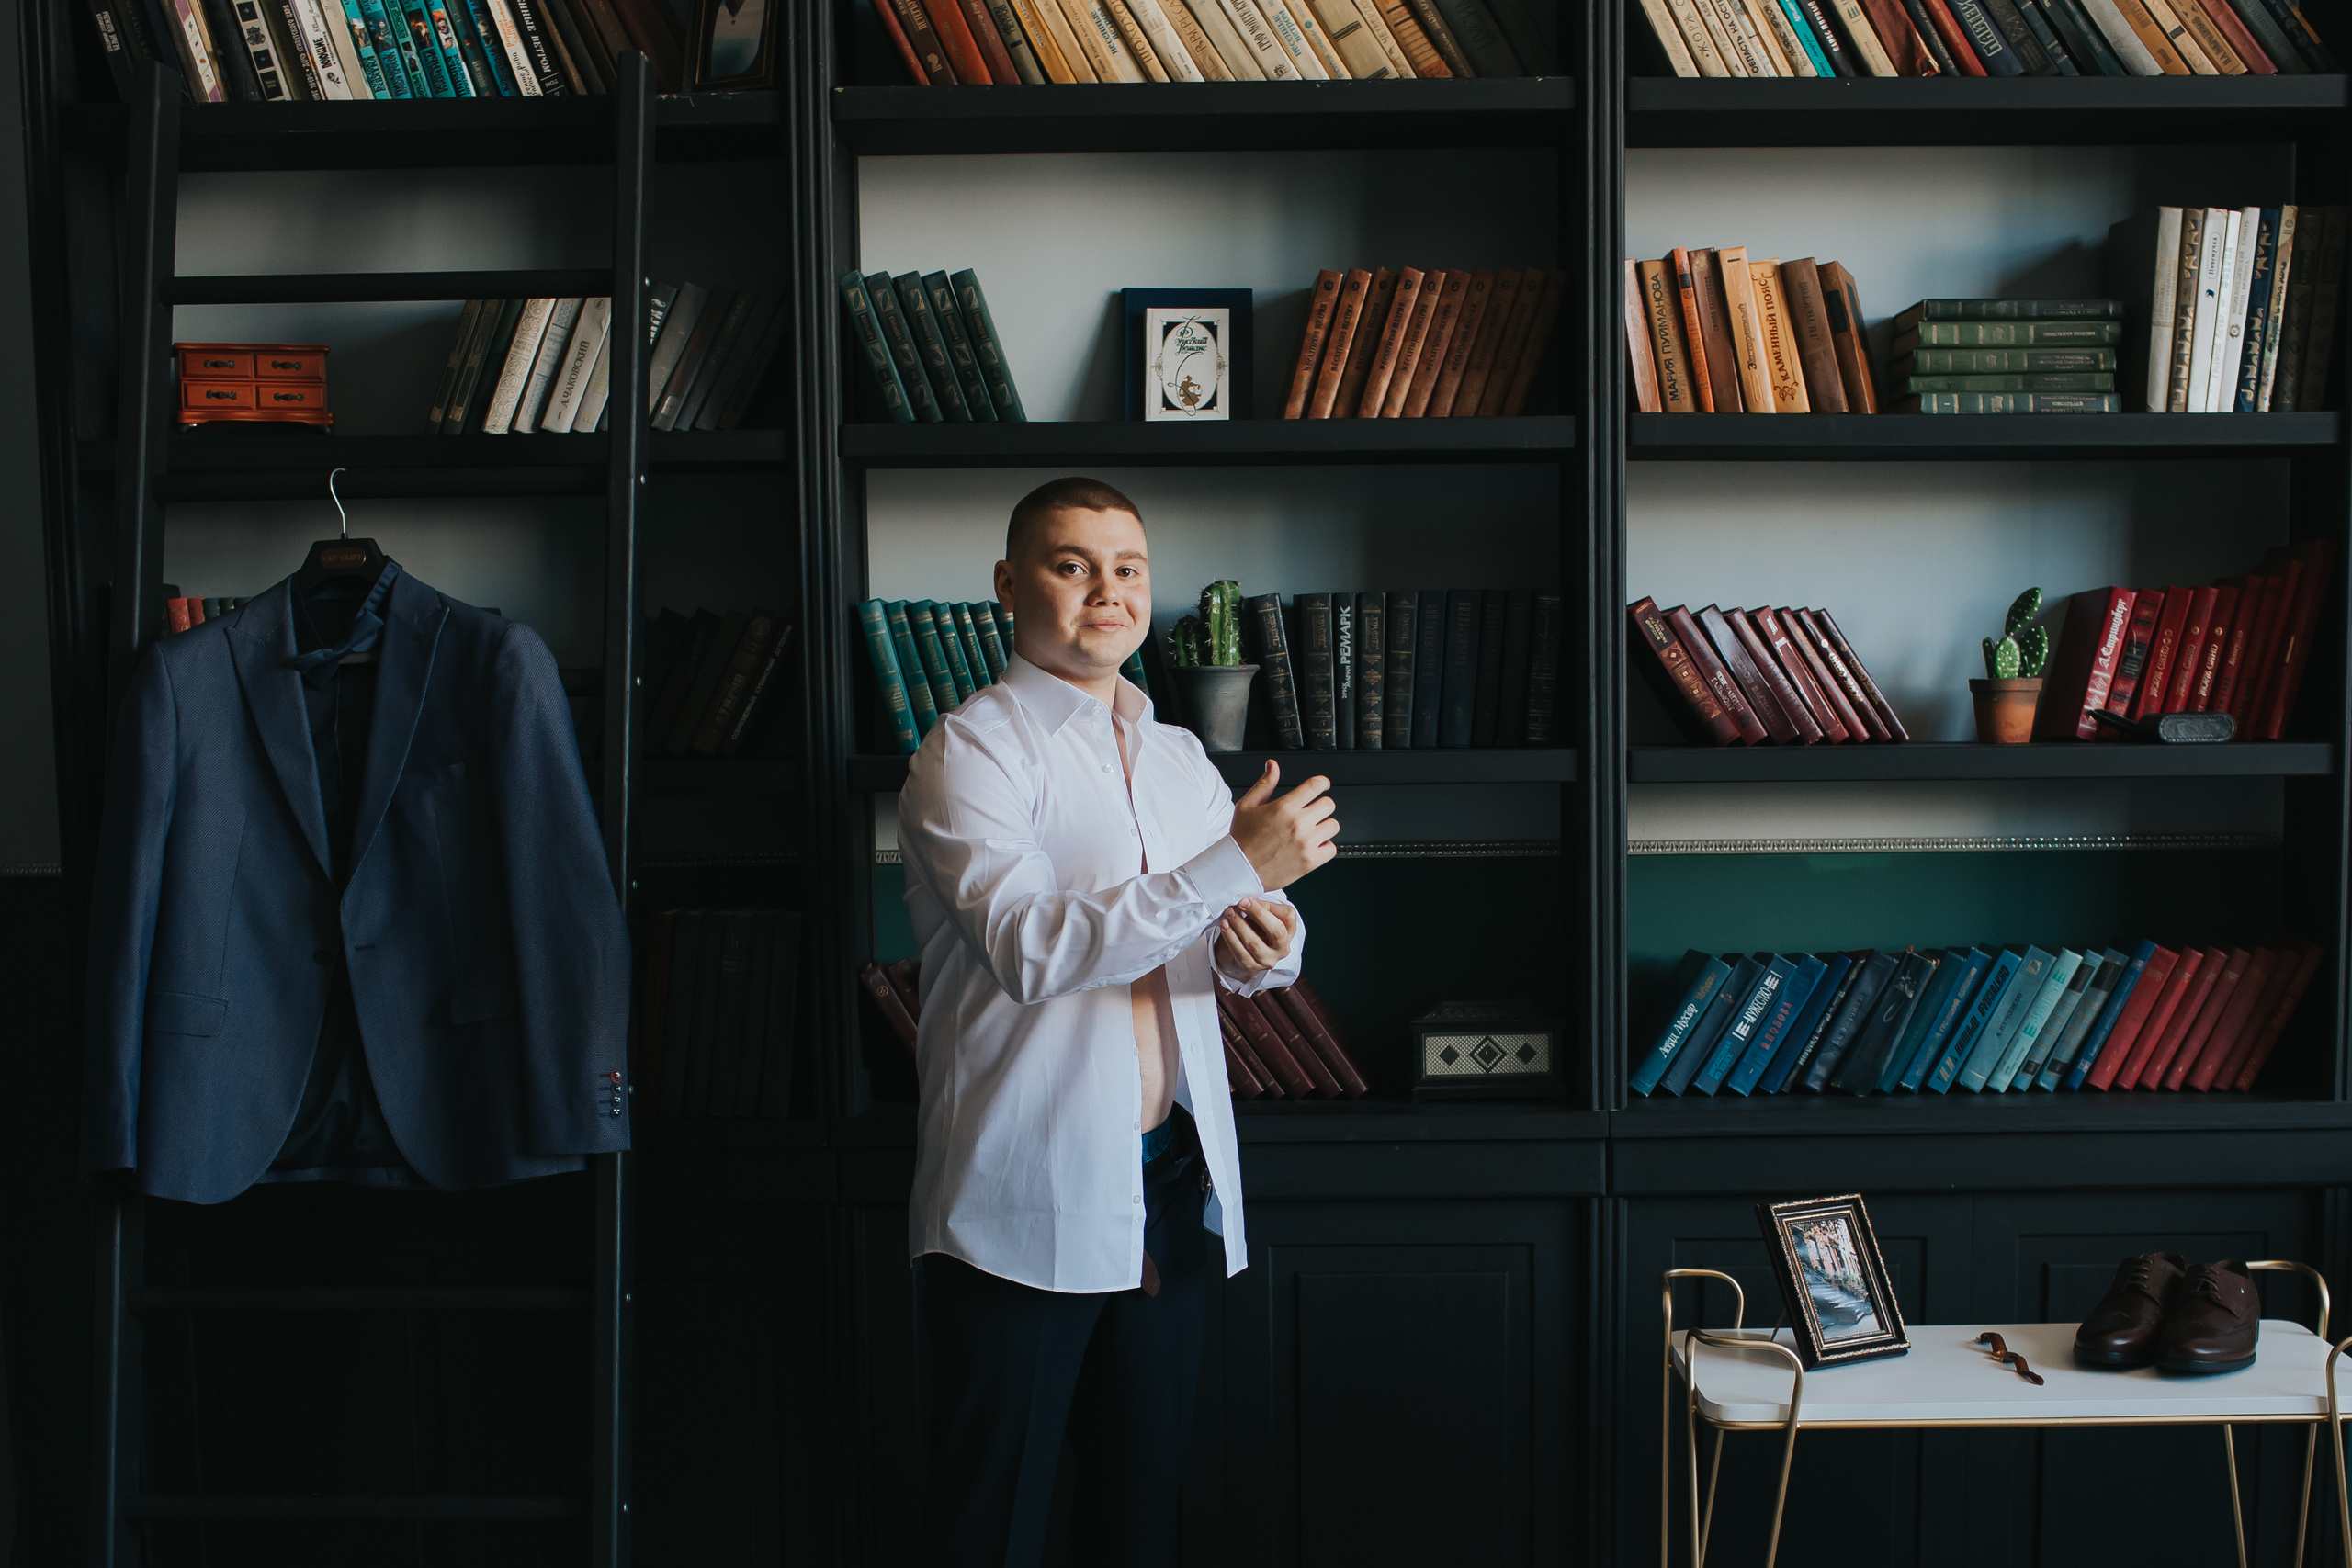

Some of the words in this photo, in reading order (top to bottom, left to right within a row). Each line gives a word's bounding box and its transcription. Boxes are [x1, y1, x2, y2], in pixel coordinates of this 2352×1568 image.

[904, 0, 928, 30] ПЕТЕРБУ
[1095, 5, 1120, 40] ветром
[1111, 1, 1153, 64] ШОЛОХО
[1277, 8, 1303, 42] ветром
[1681, 10, 1710, 56] ЖОРЖ
[1726, 18, 1738, 34] НА
[312, 36, 332, 69] ПОЮЩИЕ
[530, 34, 551, 73] ВЕТРОМ
[1251, 30, 1272, 53] ГРАФ
[1735, 32, 1760, 75] ОБЛАСТЬ
[2208, 236, 2218, 276] Почемучка
[1648, 271, 1672, 355] ПУЙМАНОВА
[1758, 277, 1775, 310] ПОЯС
[1765, 311, 1790, 382] КАМЕННЫЙ
[559, 339, 591, 409] А.ЧАКОВСКИЙ
[1662, 356, 1679, 401] МАРИЯ
[771, 623, 795, 656] ДЕТЕКТИВ
[1340, 605, 1351, 664] РЕМАРК
[2096, 597, 2130, 670] А.Стриндберг
[1732, 652, 1757, 685] БЕЛОВ
[1826, 649, 1848, 679] САНД
[2198, 669, 2212, 697] ЖОРЖ
[2205, 642, 2219, 670] САНД
[1713, 668, 1744, 713] КОНСТАНТИН
[1741, 985, 1773, 1024] МУЖЕСТВО
[1974, 964, 2013, 1016] СВЯТОСЛАВ
